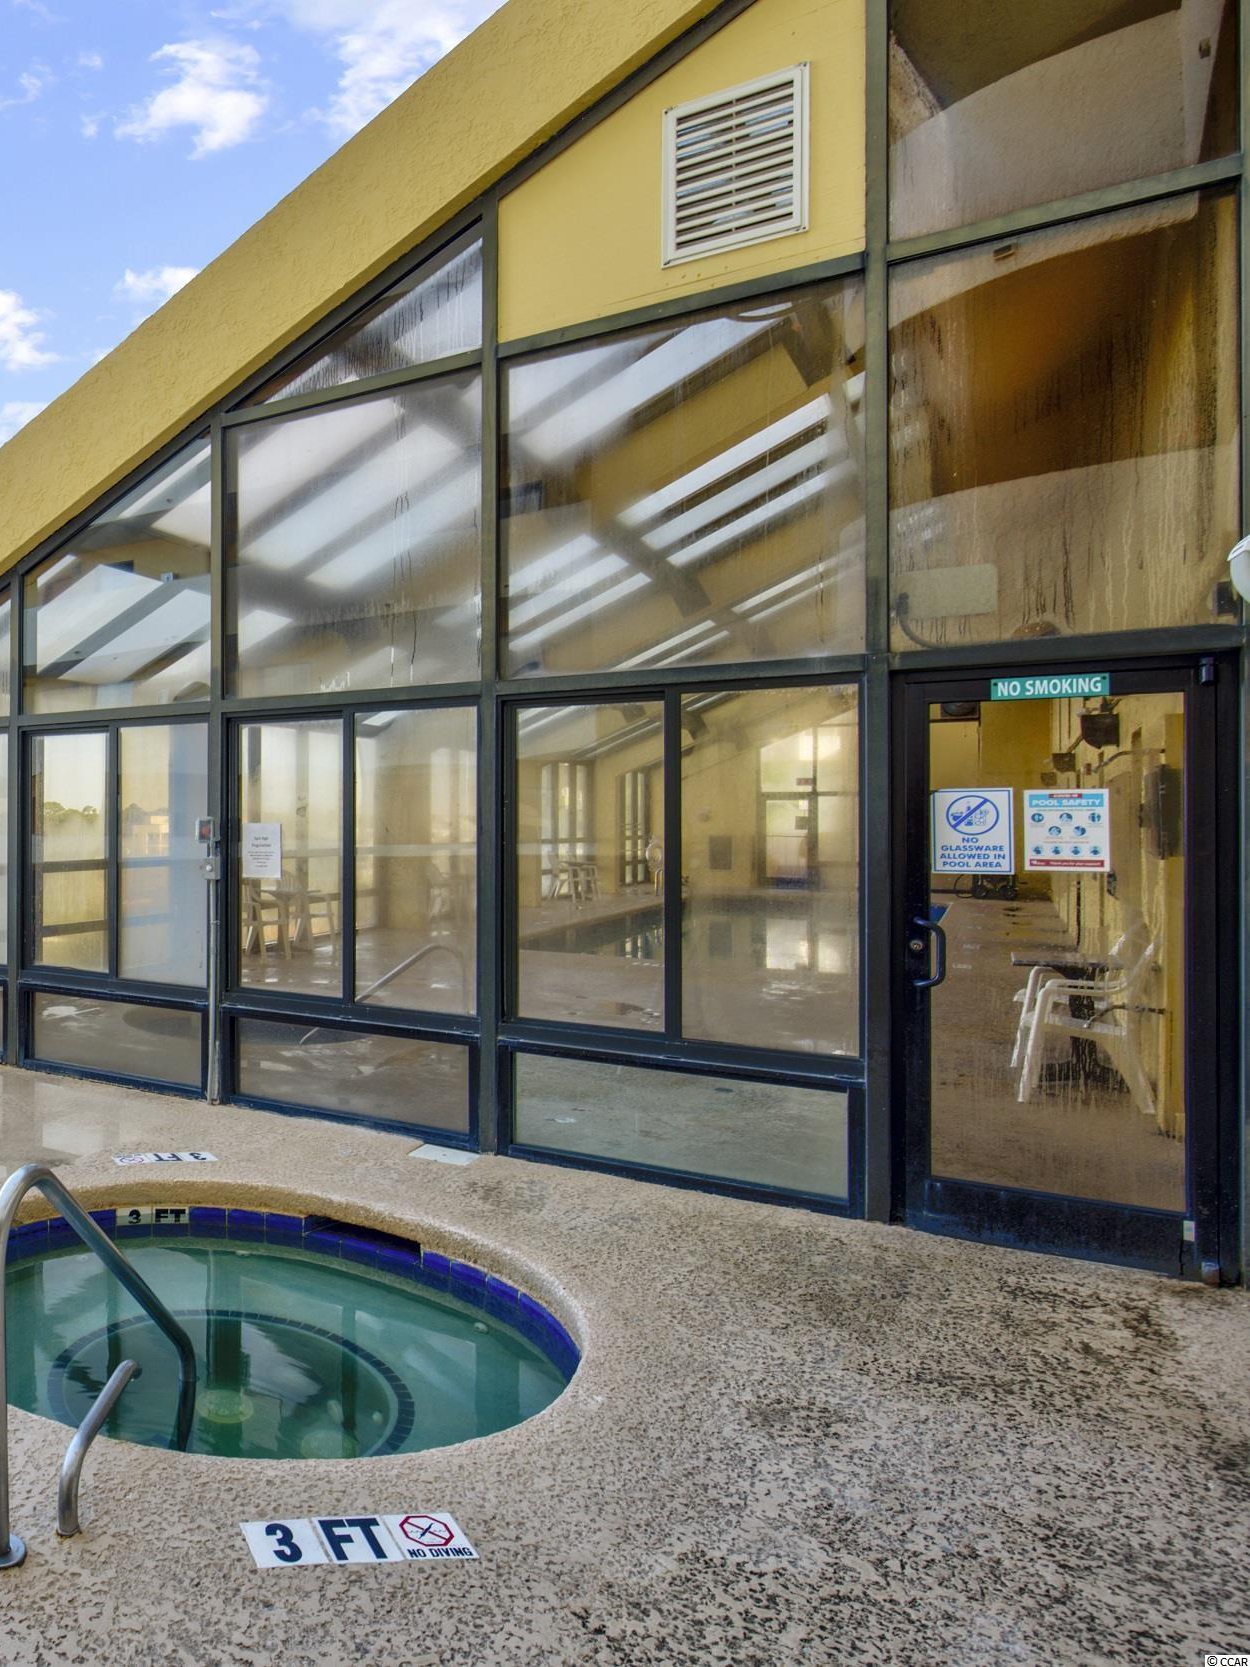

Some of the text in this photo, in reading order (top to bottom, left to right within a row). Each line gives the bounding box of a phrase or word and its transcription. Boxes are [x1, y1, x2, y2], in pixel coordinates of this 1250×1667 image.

[997, 676, 1102, 697] NO SMOKING
[1032, 799, 1101, 807] POOL SAFETY
[153, 1152, 184, 1162] FT
[189, 1152, 207, 1161] 3
[128, 1208, 186, 1224] 3 FT
[264, 1516, 389, 1563] 3 FT
[407, 1546, 474, 1559] NO DIVING
